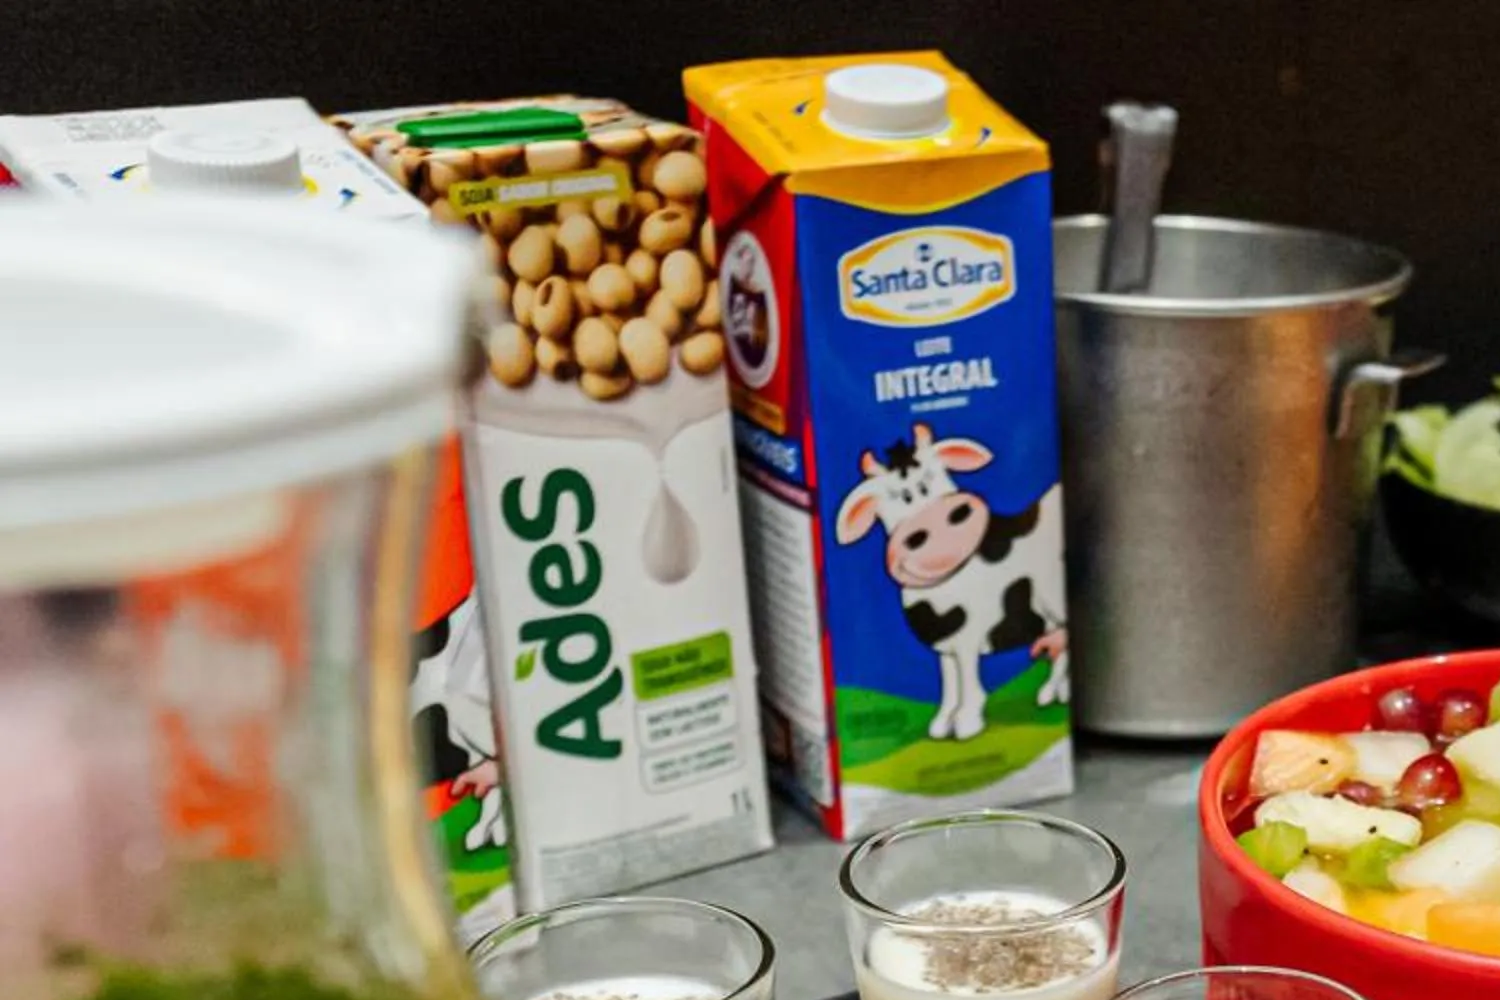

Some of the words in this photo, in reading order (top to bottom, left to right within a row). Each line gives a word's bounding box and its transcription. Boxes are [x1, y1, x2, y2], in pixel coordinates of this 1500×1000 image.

[852, 266, 928, 298] Santa
[932, 257, 1003, 288] Clara
[874, 356, 999, 403] INTEGRAL
[502, 467, 623, 760] AdeS
